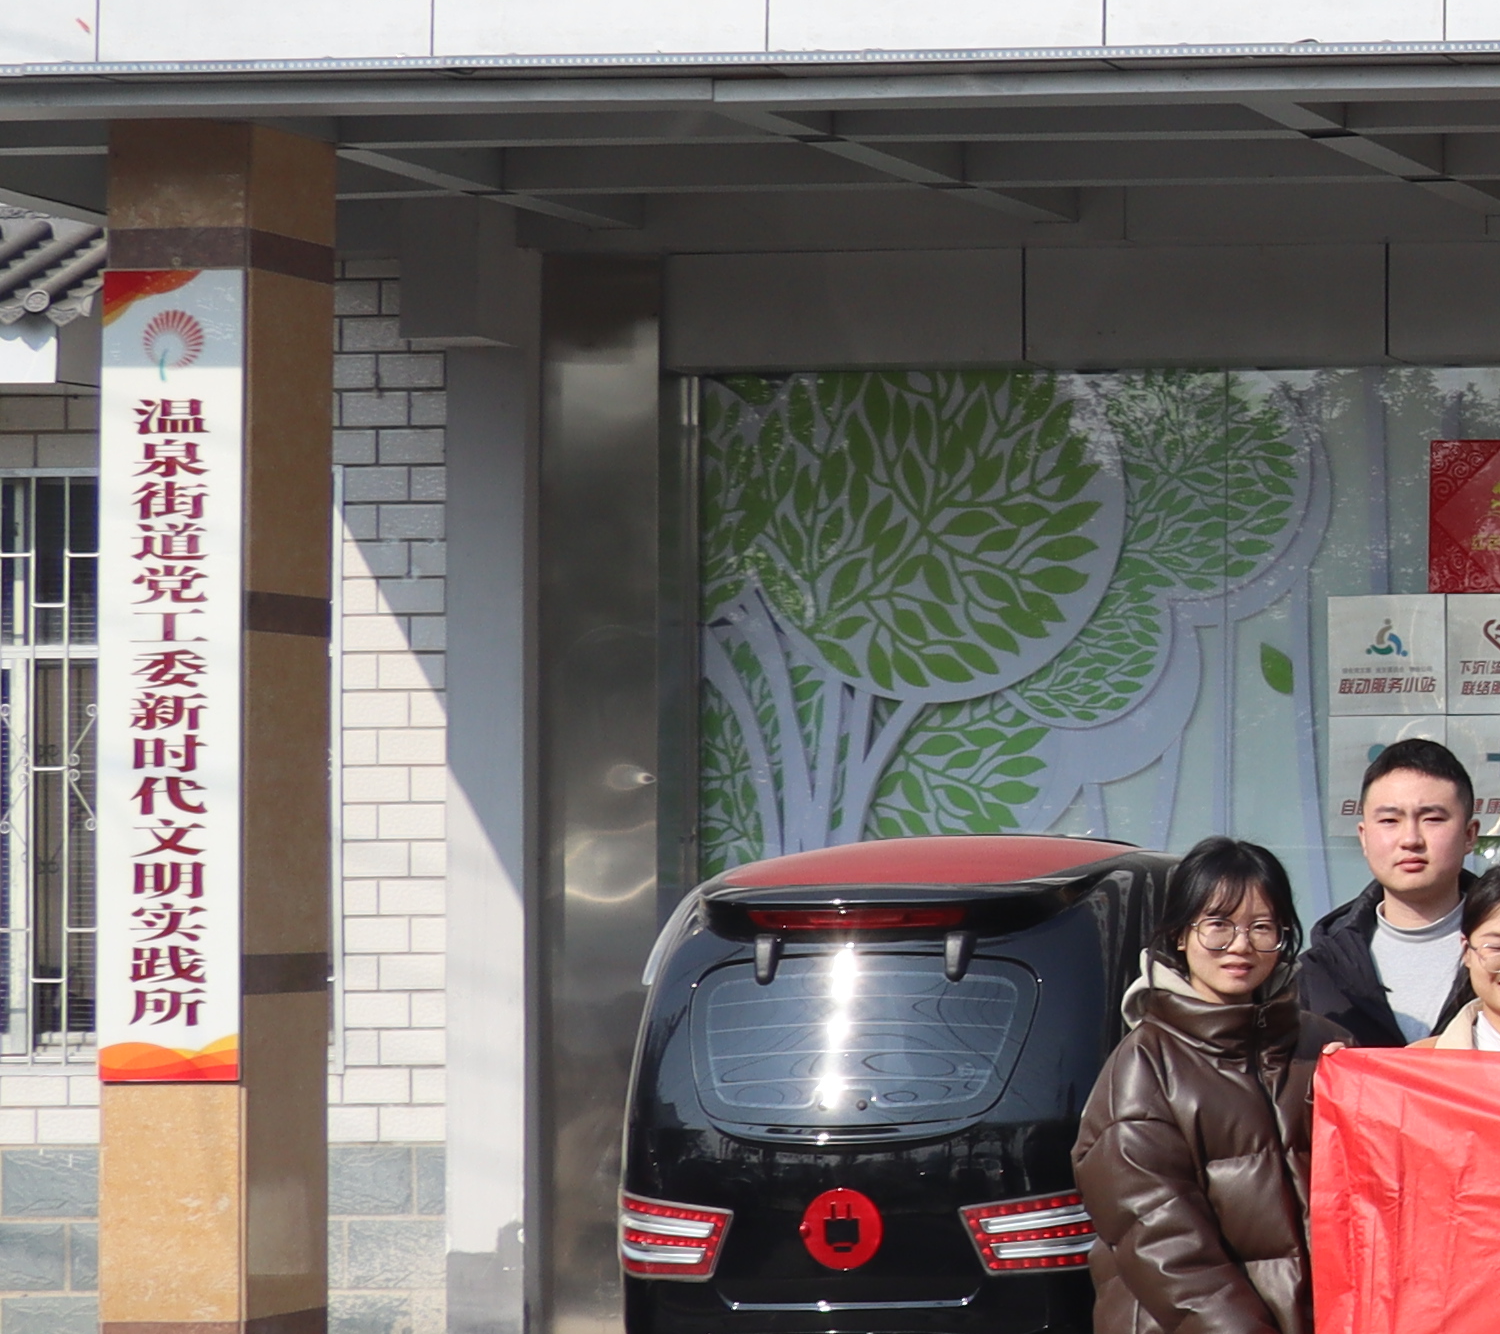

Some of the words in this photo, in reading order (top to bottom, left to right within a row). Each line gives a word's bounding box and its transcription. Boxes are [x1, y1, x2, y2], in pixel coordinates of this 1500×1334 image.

[129, 397, 212, 1028] 温泉街道党工委新时代文明实践所
